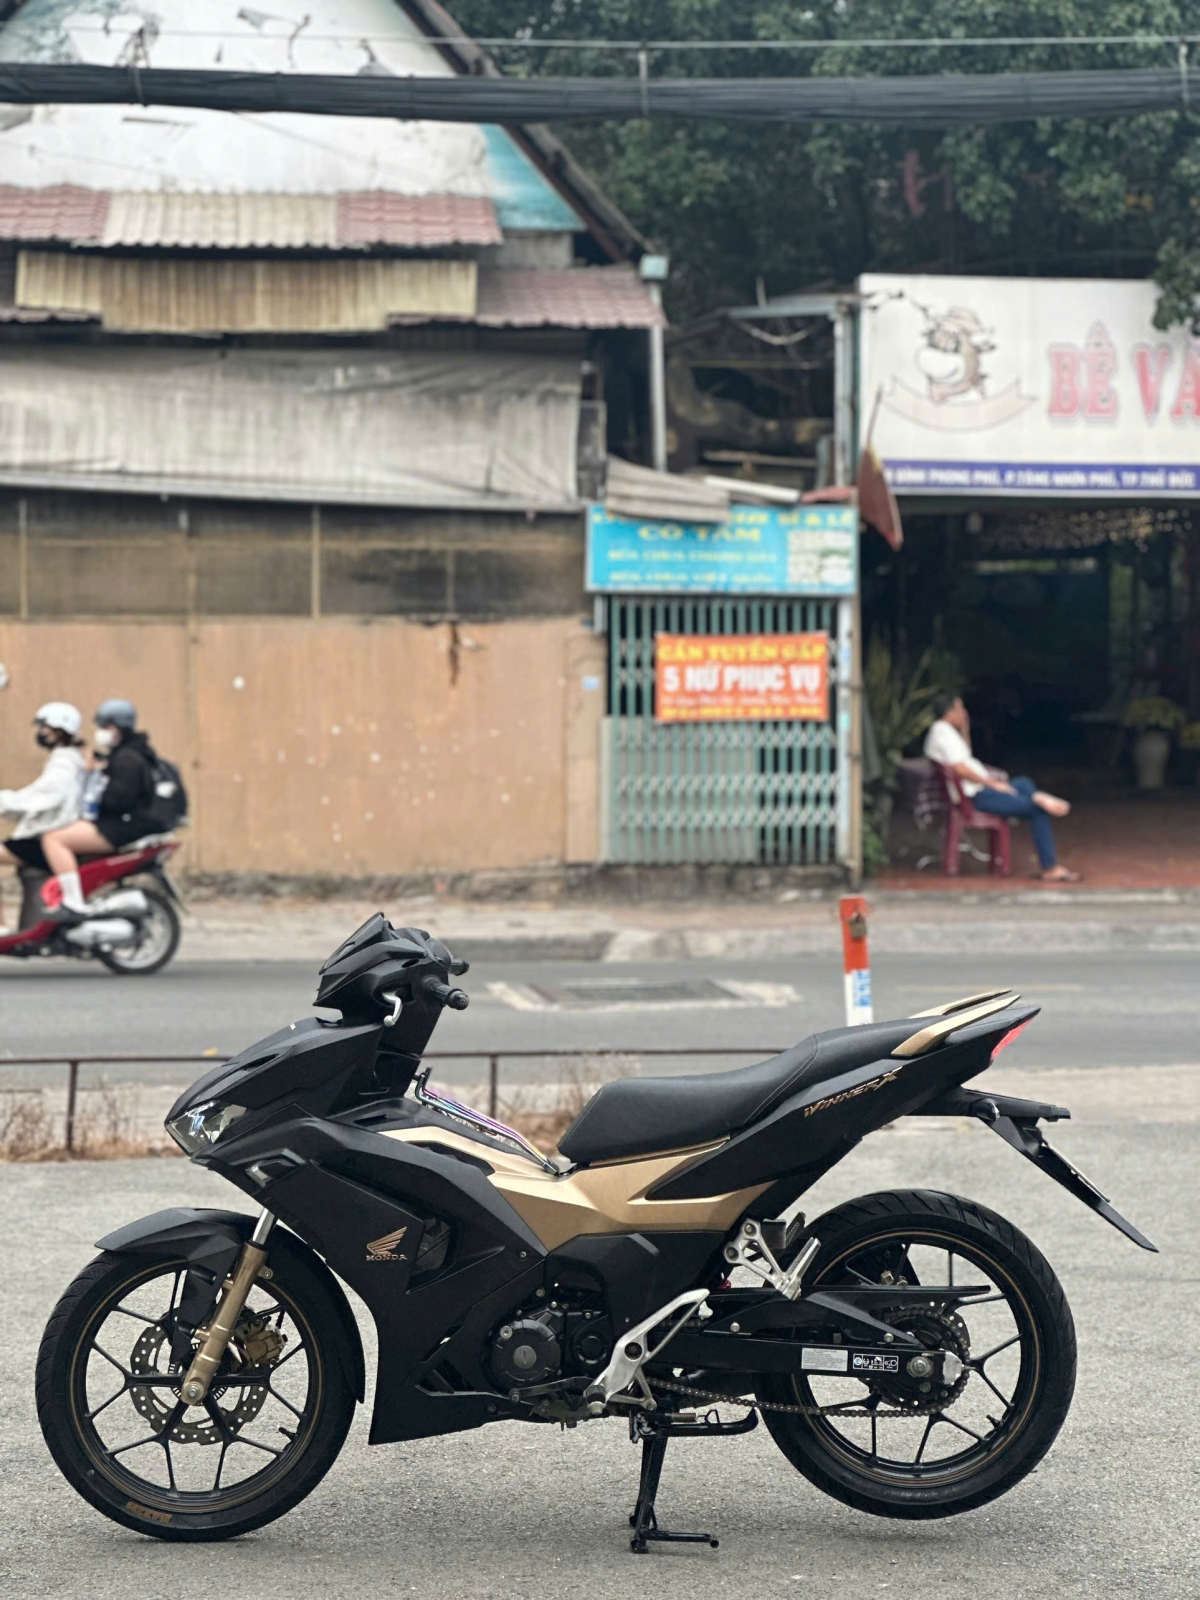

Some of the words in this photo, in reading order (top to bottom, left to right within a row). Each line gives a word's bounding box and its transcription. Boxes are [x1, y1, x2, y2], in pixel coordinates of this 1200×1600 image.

[1047, 319, 1116, 422] BÊ
[723, 664, 785, 696] PHỤC
[789, 664, 821, 696] VỤ
